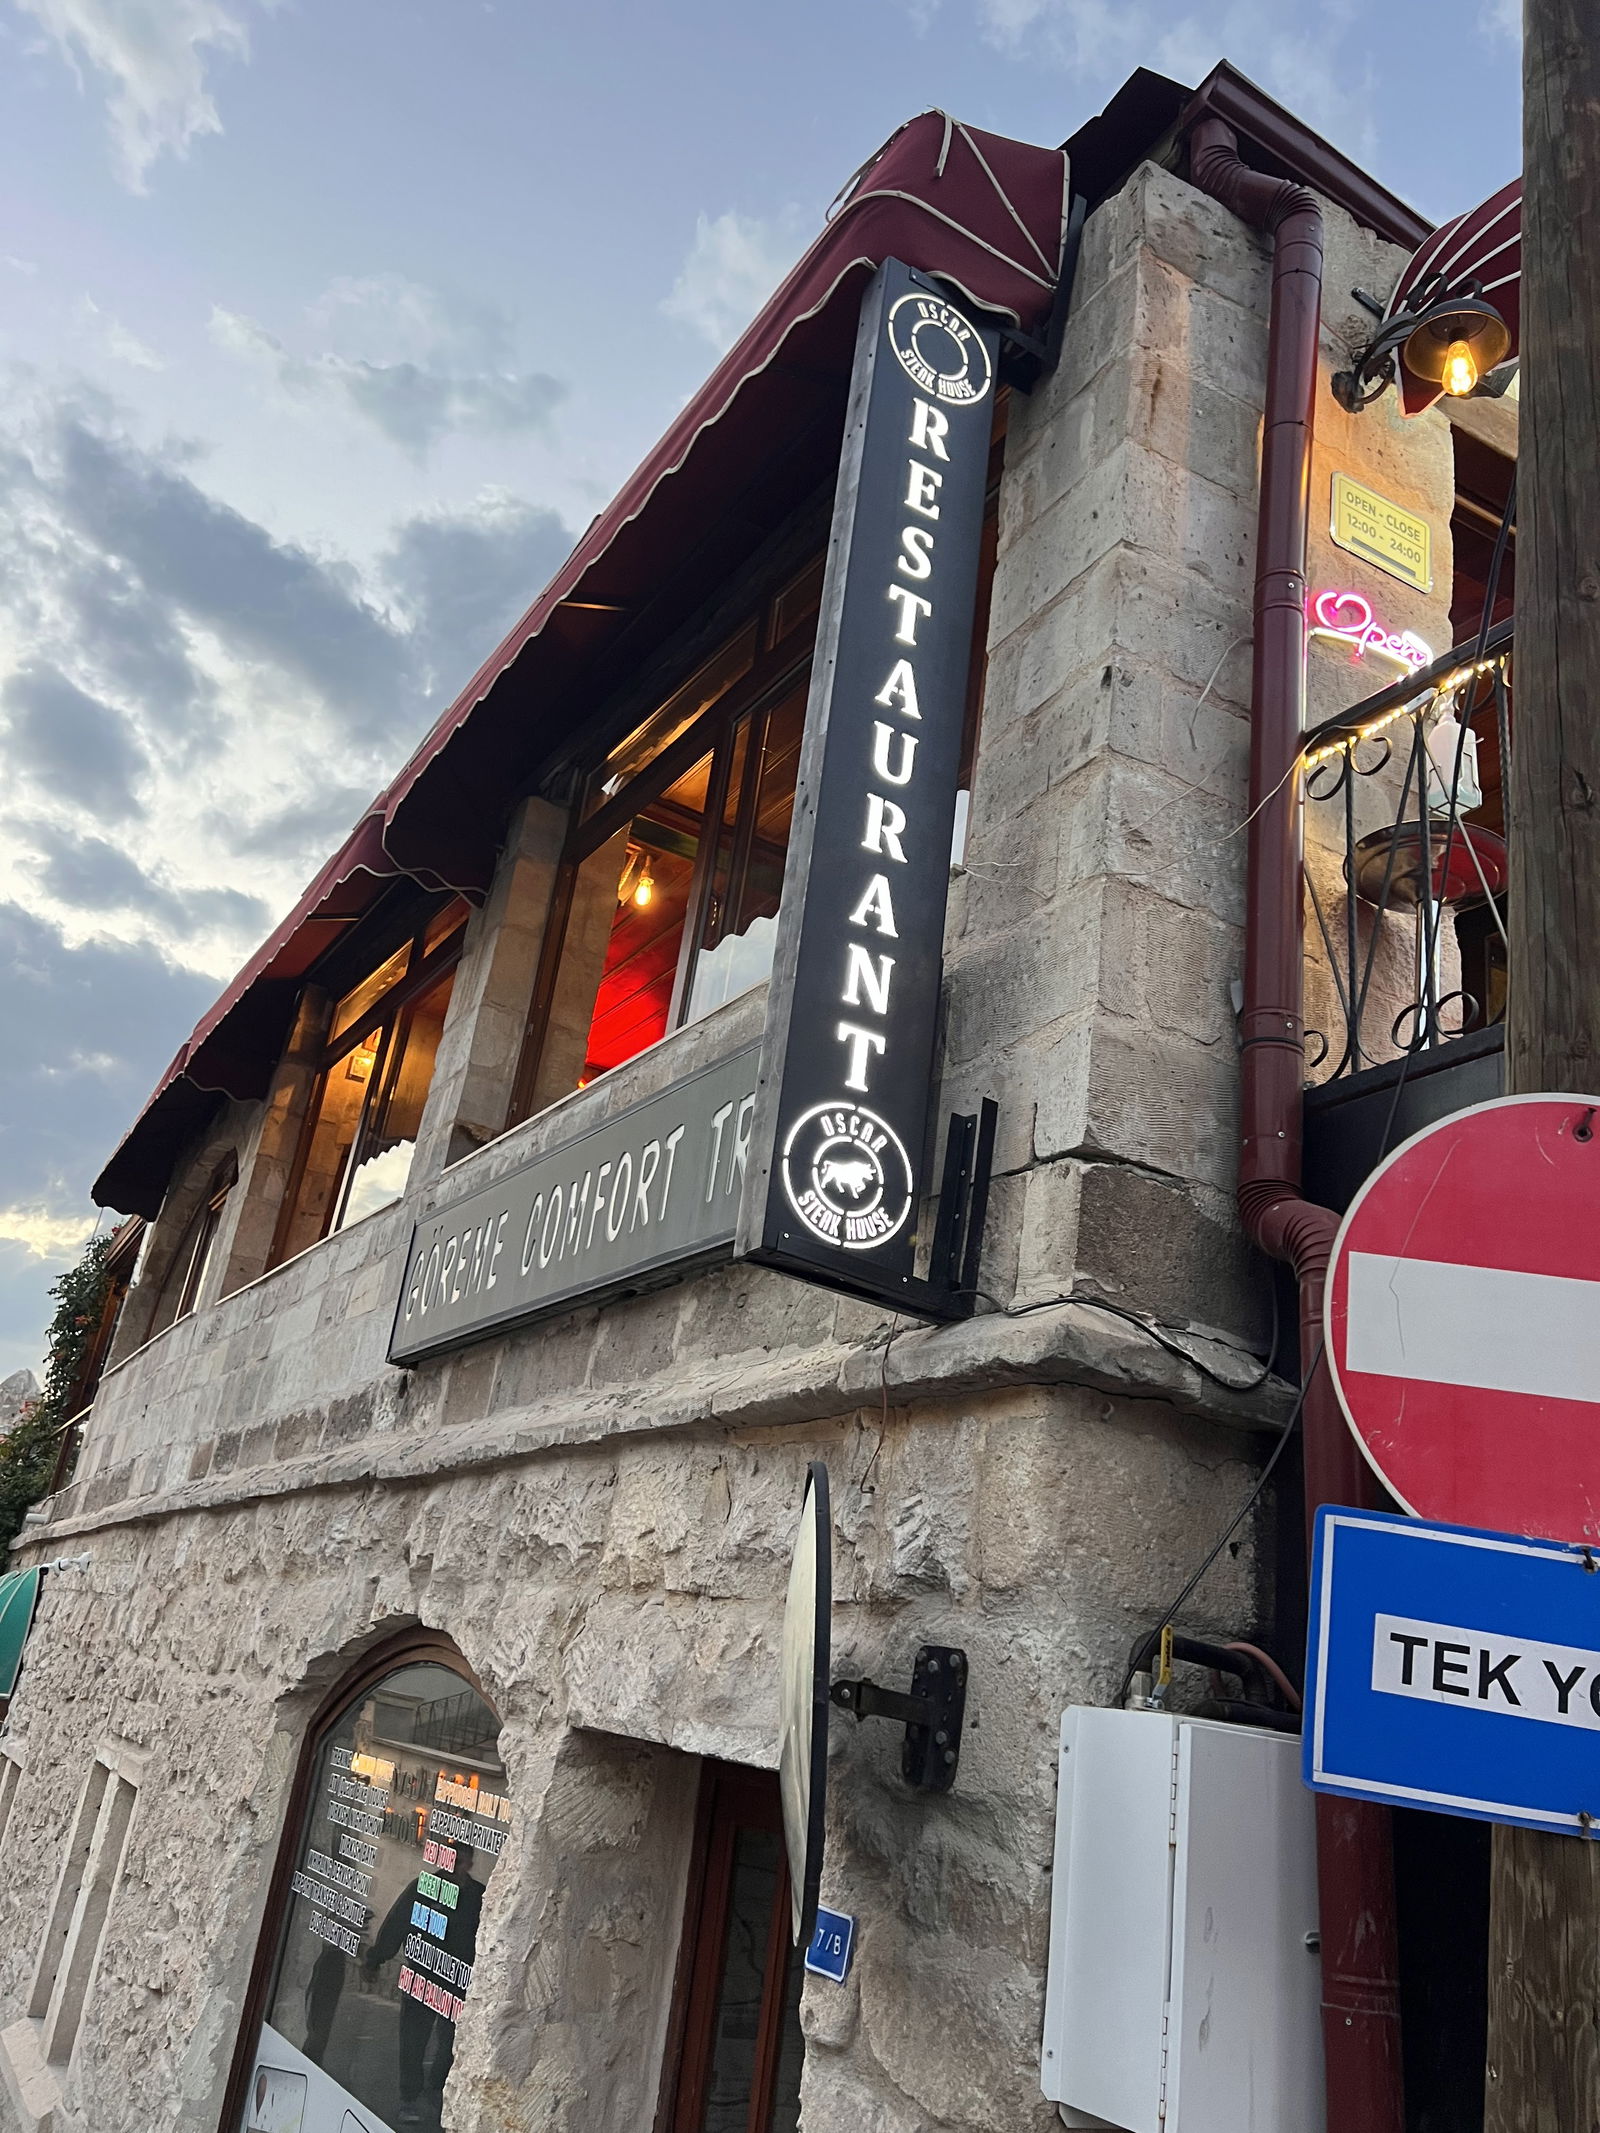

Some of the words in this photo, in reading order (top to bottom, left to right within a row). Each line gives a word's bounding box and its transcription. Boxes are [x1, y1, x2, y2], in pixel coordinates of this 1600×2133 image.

[917, 302, 971, 341] OSCAR
[901, 349, 936, 388] STEAK
[938, 378, 976, 398] HOUSE
[1346, 491, 1376, 517] OPEN
[1386, 513, 1421, 542] CLOSE
[1347, 513, 1377, 539] 12:00
[1390, 537, 1421, 564] 24:00
[837, 397, 951, 1093] RESTAURANT
[820, 1112, 888, 1153] OSCAR
[405, 1210, 508, 1321] GÖREME
[520, 1124, 685, 1277] COMFORT
[797, 1189, 842, 1237] STEAK
[845, 1207, 895, 1240] HOUSE
[1390, 1632, 1522, 1707] TEK
[435, 1778, 479, 1813] CAPPADOCIA
[477, 1790, 500, 1819] DAILY
[429, 1809, 473, 1846] CAPPADOCIA
[471, 1823, 502, 1856] PRIVATE
[423, 1839, 439, 1865] RED
[437, 1844, 457, 1873] TOUR
[417, 1870, 441, 1901] GREEN
[439, 1879, 459, 1910] TOUR
[411, 1901, 430, 1931] BLUE
[428, 1908, 448, 1941] TOUR
[398, 1965, 414, 1995] HOT
[411, 1973, 426, 2002] AIR
[433, 1947, 460, 1985] VALLEY
